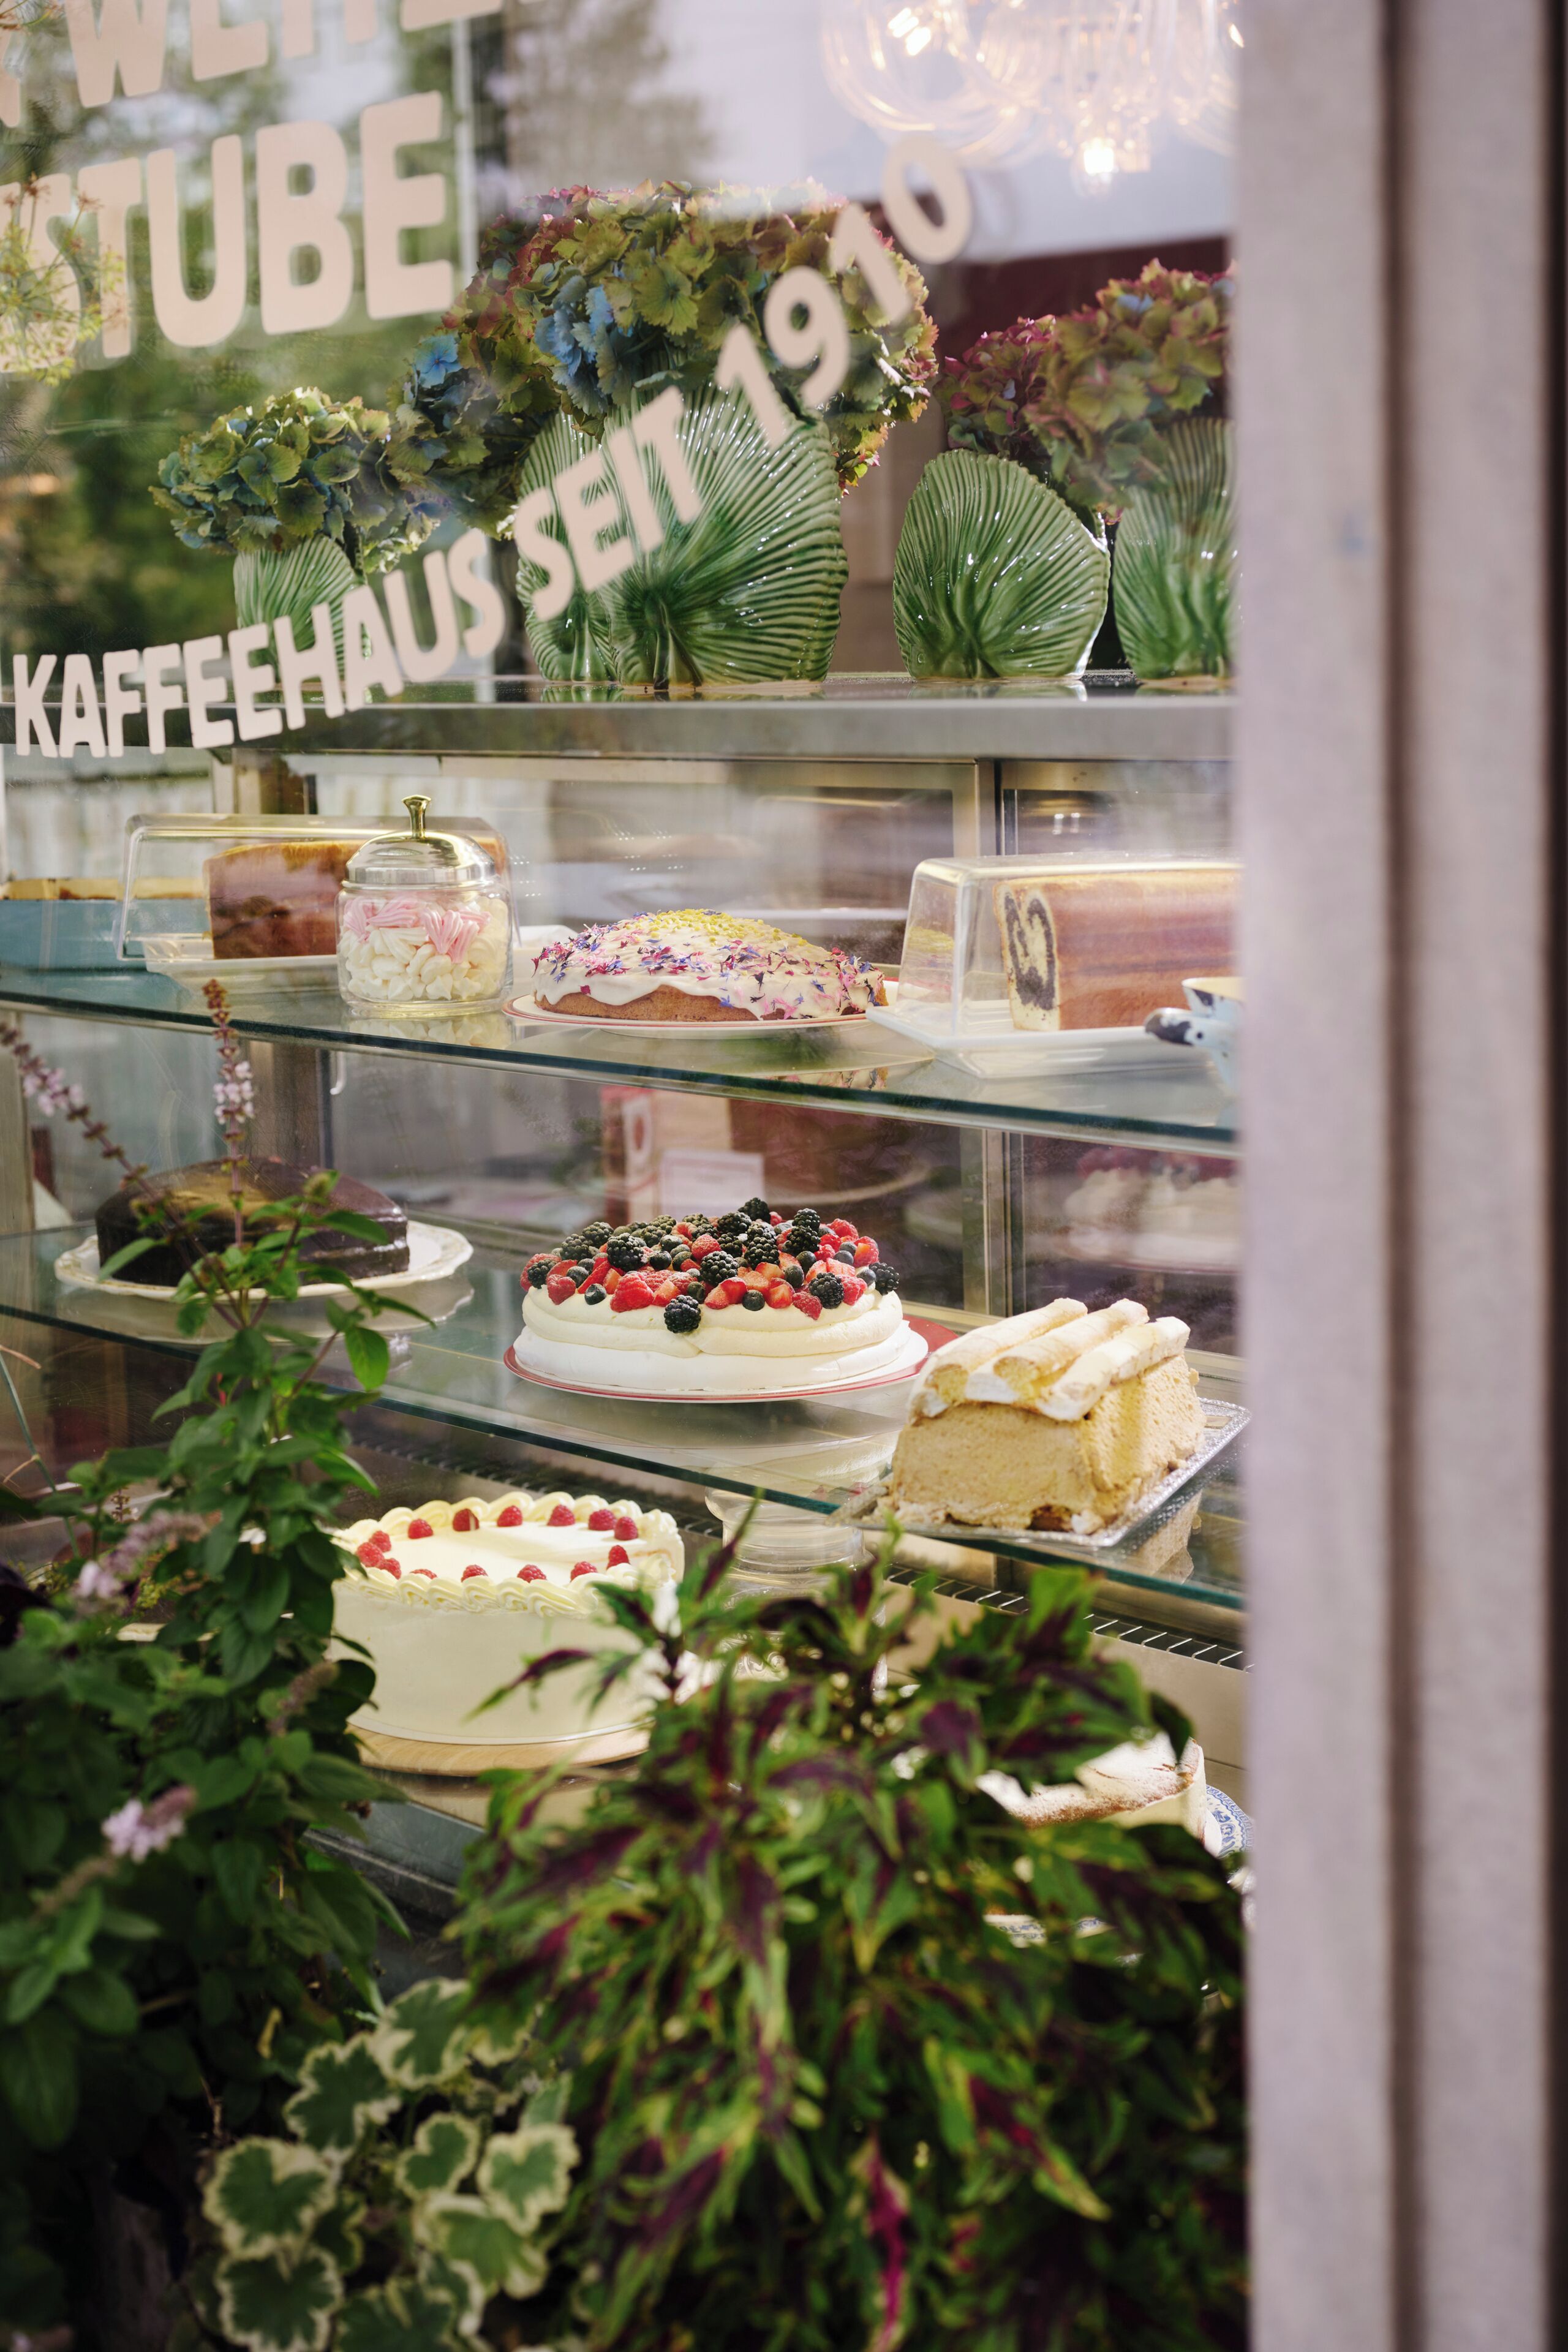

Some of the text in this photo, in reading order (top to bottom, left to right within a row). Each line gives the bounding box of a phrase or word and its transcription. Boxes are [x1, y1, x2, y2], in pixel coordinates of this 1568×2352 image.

[0, 90, 453, 372] STUBE
[13, 132, 972, 758] KAFFEEHAUS SEIT 1910
